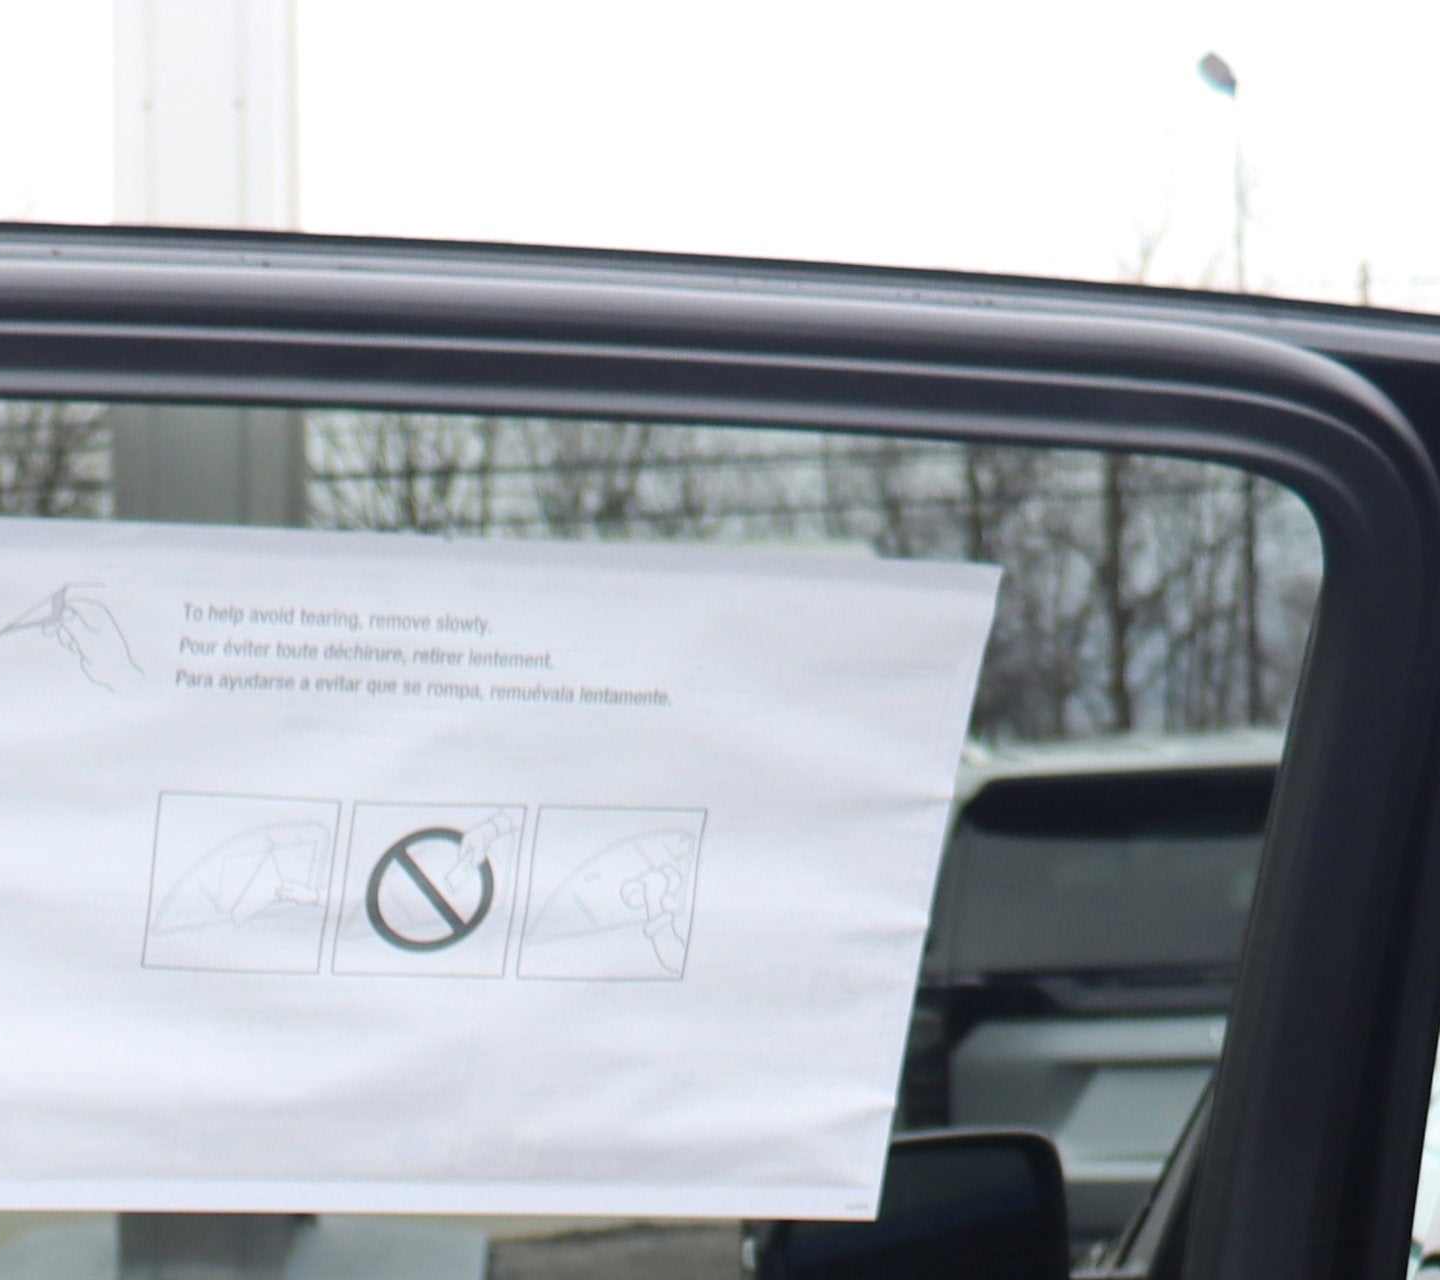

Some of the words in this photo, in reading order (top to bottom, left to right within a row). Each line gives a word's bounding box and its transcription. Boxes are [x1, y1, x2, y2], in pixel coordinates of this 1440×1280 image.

[183, 602, 203, 622] To
[208, 604, 244, 626] help
[249, 606, 294, 626] avoid
[300, 608, 363, 633] tearing,
[368, 612, 431, 631] remove
[436, 614, 492, 637] slowly.
[179, 636, 217, 656] Pour
[223, 637, 271, 658] éviter
[276, 640, 318, 660] toute
[323, 642, 407, 666] déchirure,
[412, 646, 464, 667] retirer
[468, 648, 554, 670] lentement.
[175, 668, 213, 688] Para
[218, 670, 294, 693] ayudarse
[299, 675, 311, 691] a
[315, 673, 362, 693] evitar
[366, 679, 398, 698] que
[402, 679, 422, 695] se
[427, 680, 484, 703] rompa,
[489, 683, 574, 704] remuévala
[579, 684, 672, 707] lentamente.
